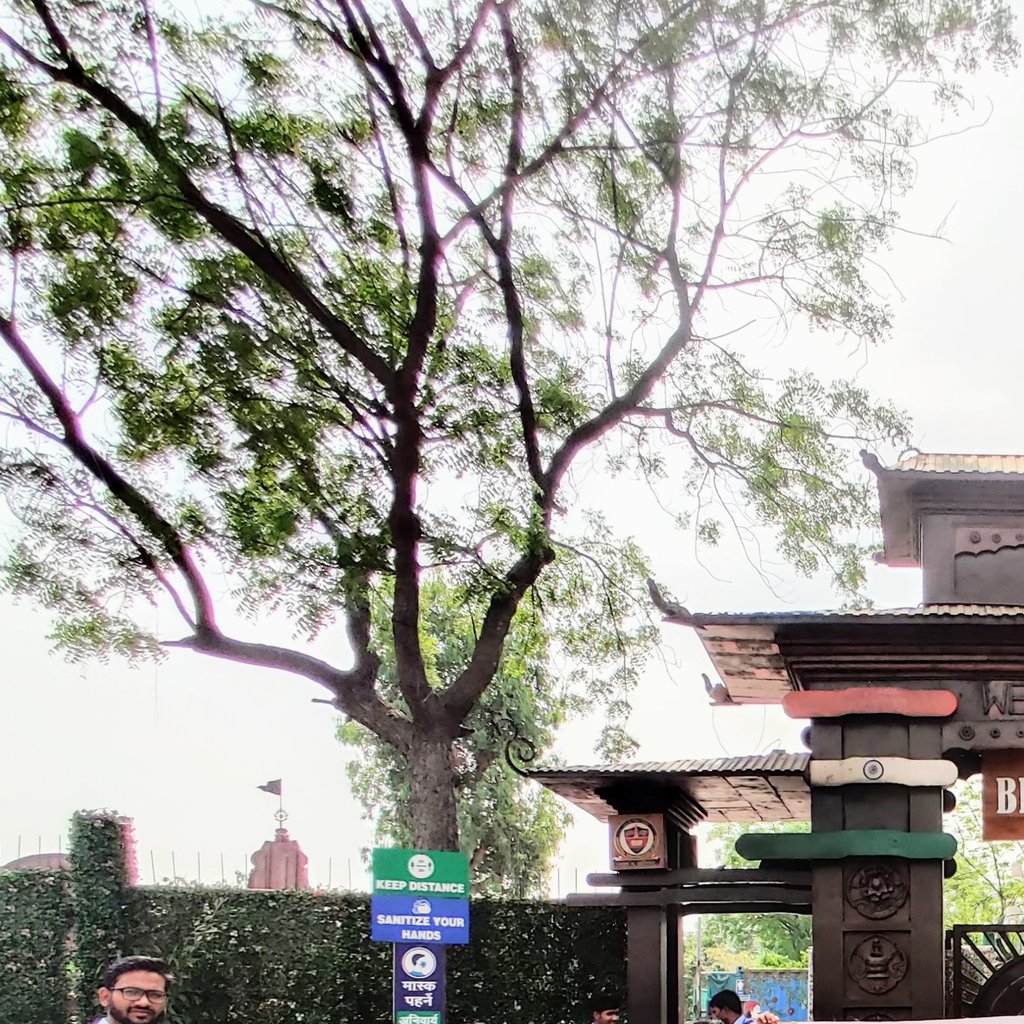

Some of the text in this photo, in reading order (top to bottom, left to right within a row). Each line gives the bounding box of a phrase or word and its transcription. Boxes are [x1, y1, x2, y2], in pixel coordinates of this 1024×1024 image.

[376, 879, 464, 893] KEEP DISTANCE
[377, 915, 464, 927] SANITIZE YOUR
[402, 930, 441, 941] HANDS
[402, 980, 437, 992] मास्क
[405, 993, 433, 1008] पहनें
